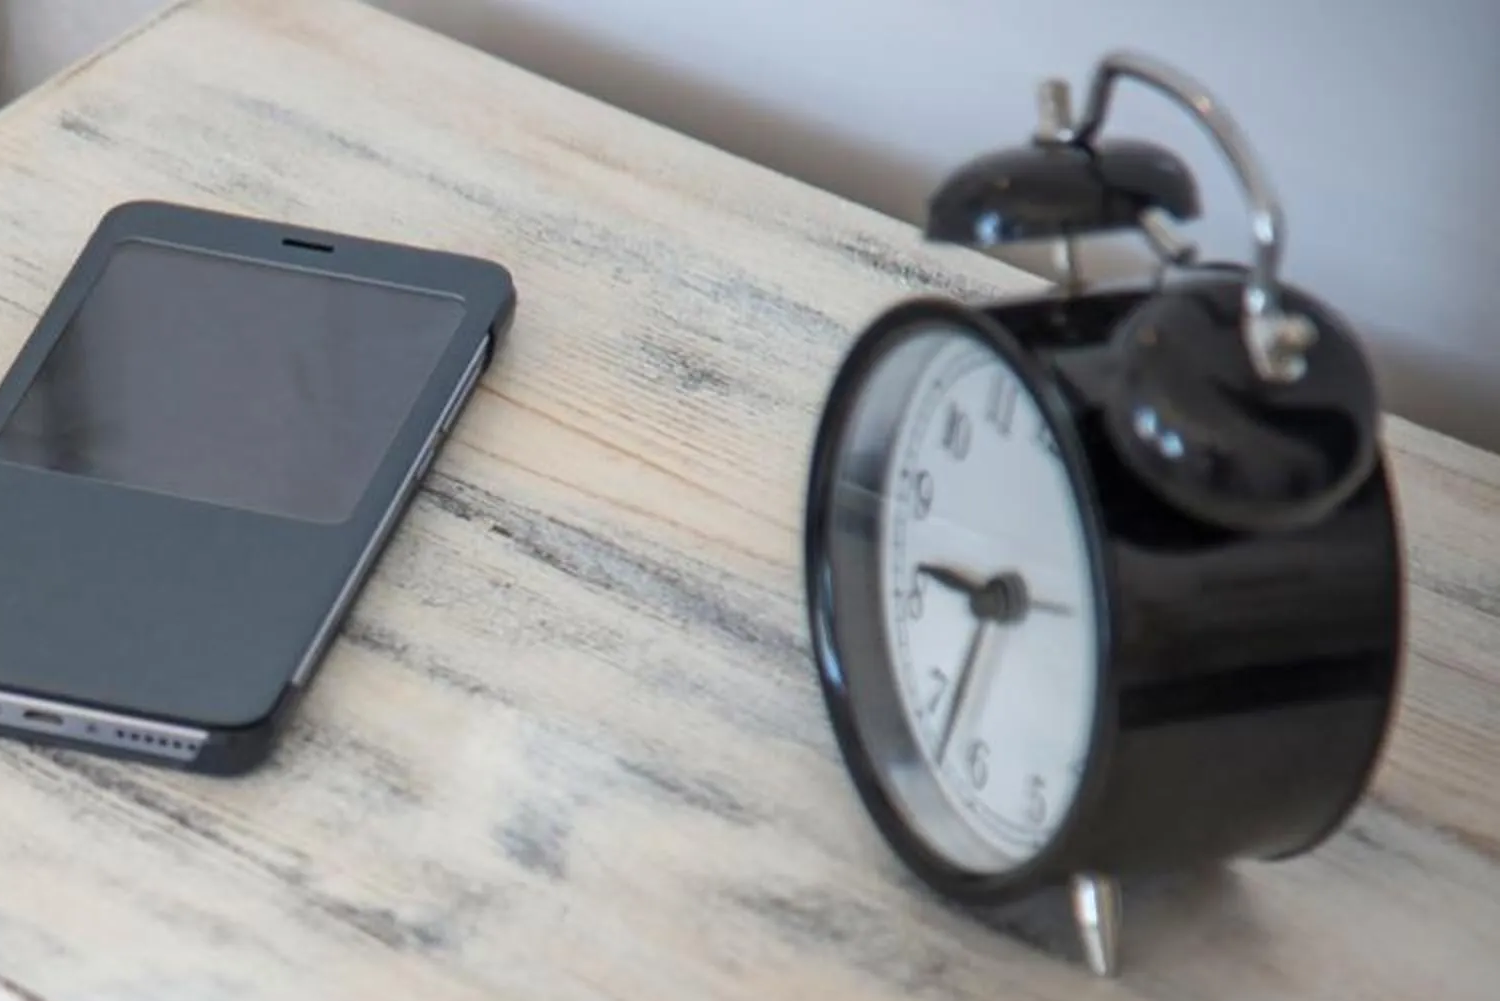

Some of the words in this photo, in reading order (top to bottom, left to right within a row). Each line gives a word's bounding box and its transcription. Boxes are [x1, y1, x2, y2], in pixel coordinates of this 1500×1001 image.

[941, 400, 973, 463] 10
[913, 469, 935, 521] 9
[927, 665, 950, 713] 7
[965, 739, 991, 791] 6
